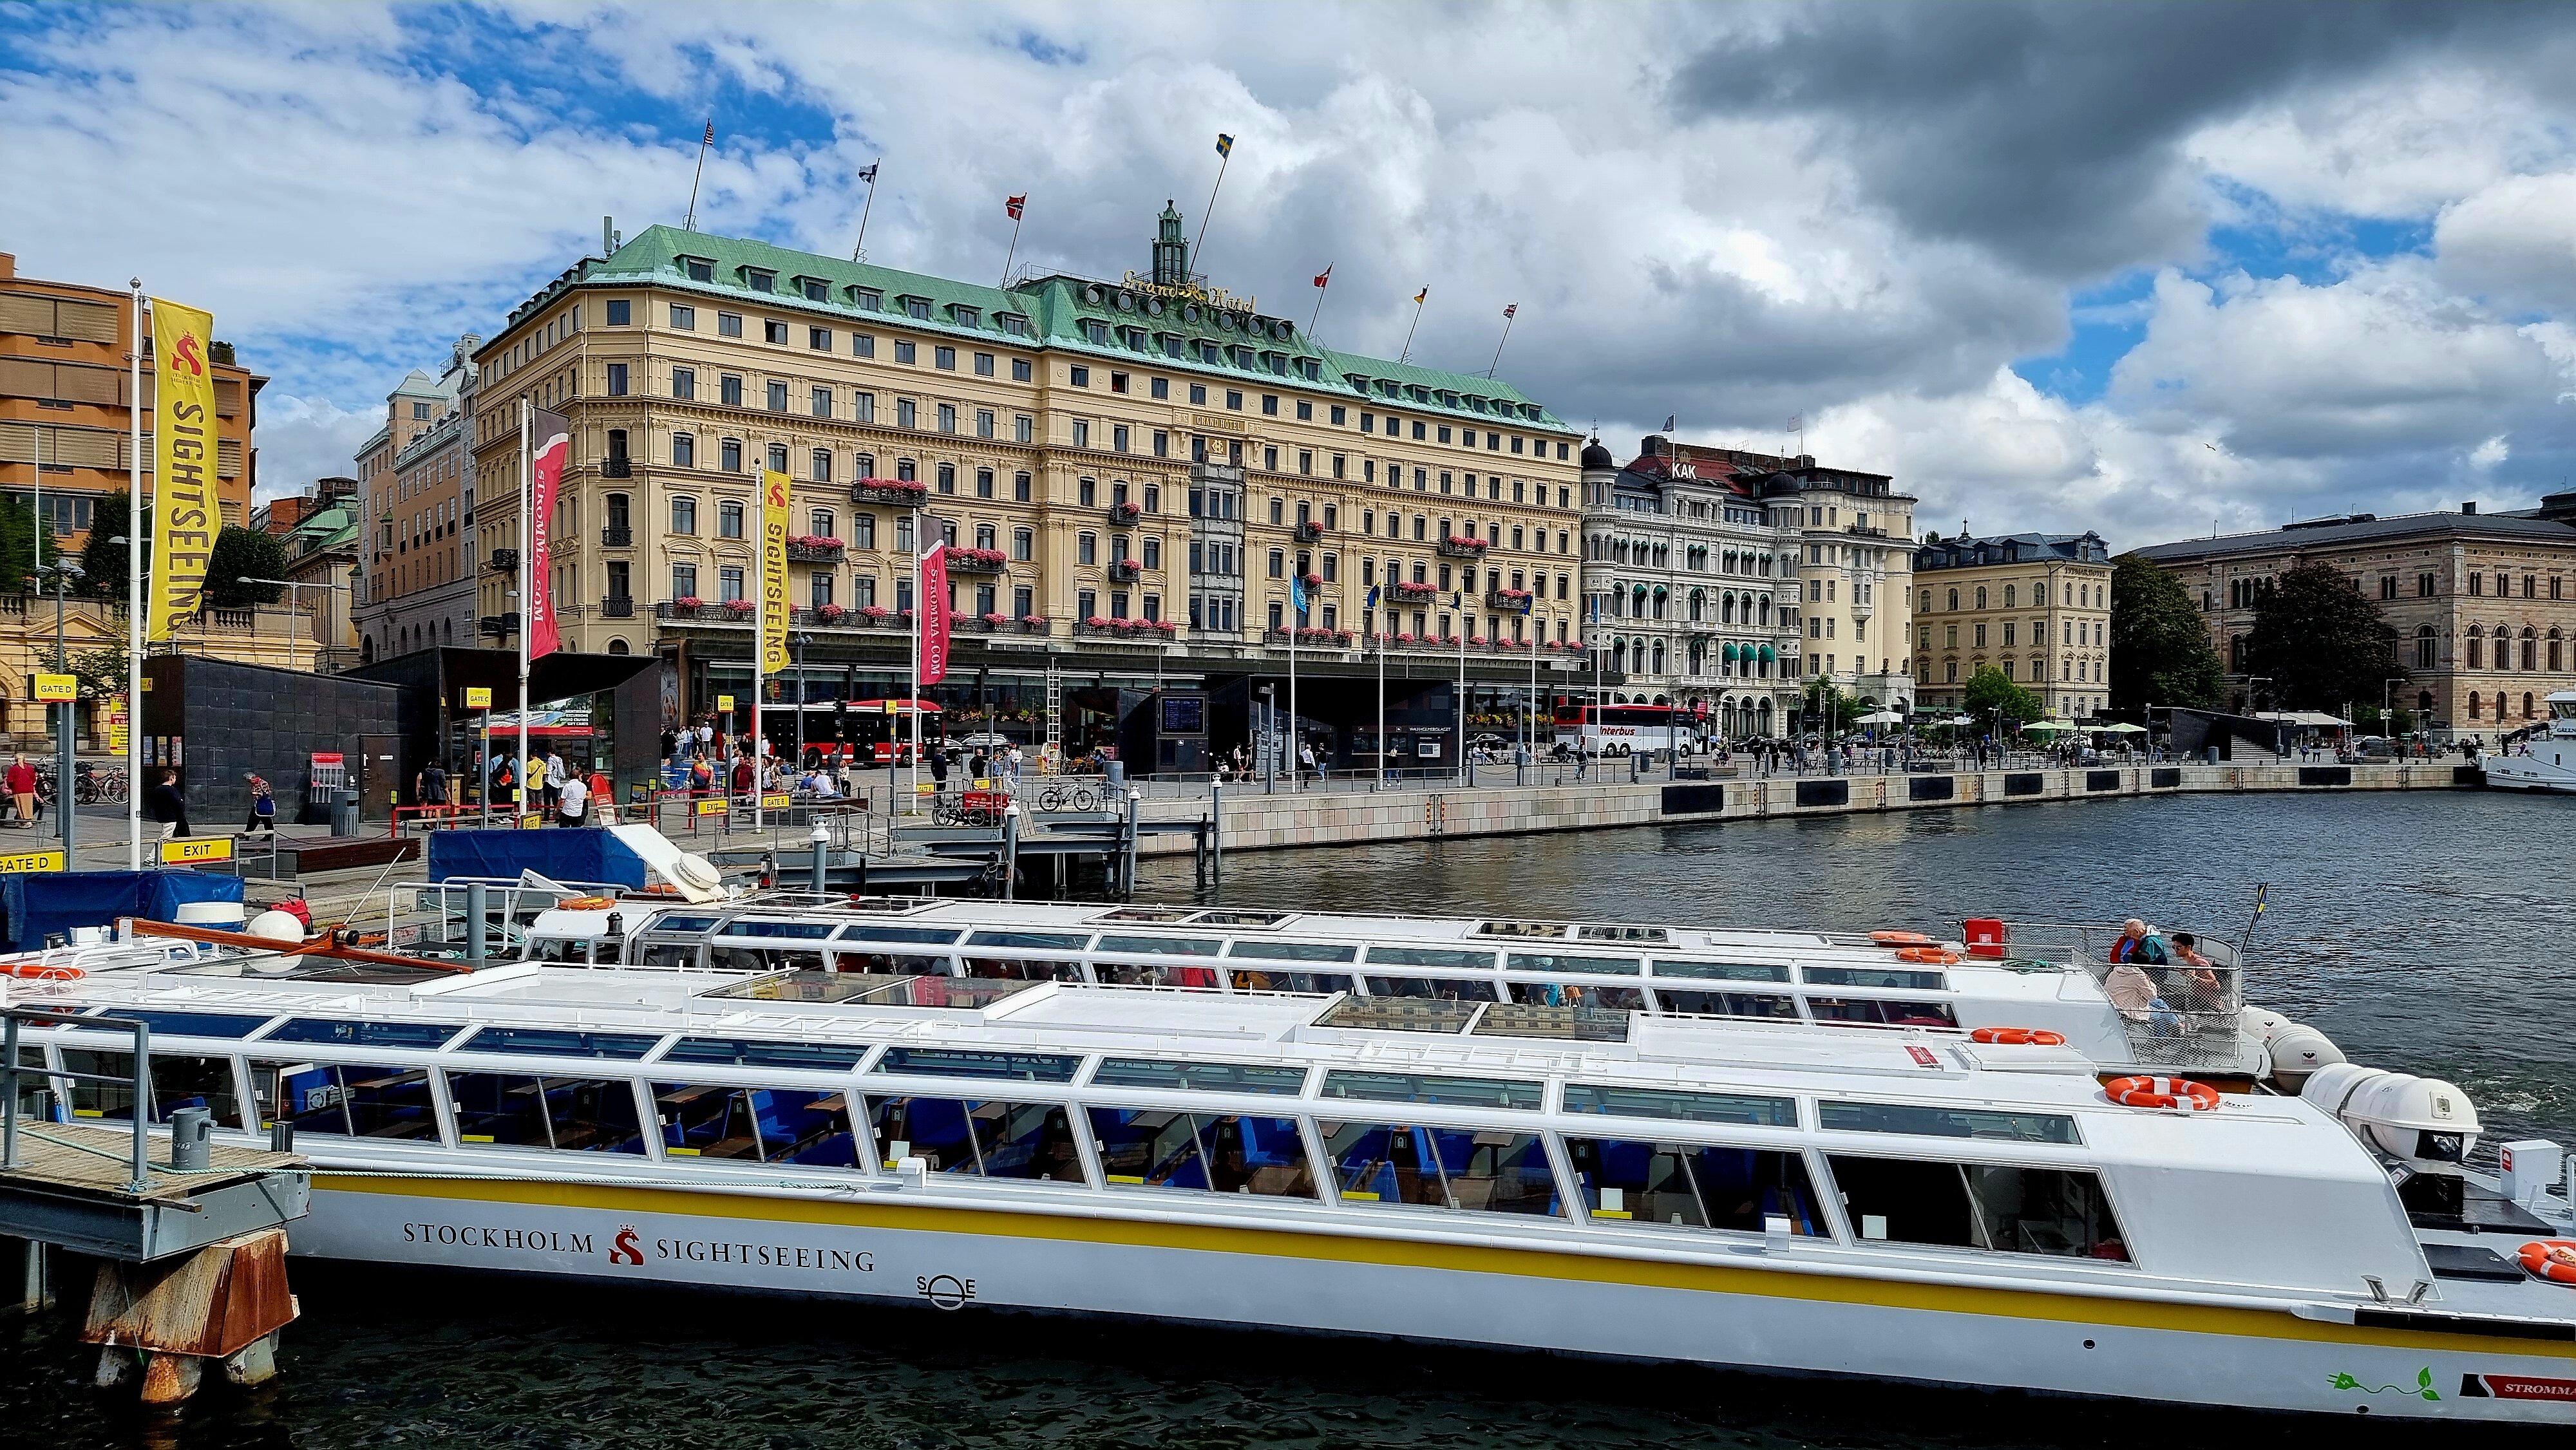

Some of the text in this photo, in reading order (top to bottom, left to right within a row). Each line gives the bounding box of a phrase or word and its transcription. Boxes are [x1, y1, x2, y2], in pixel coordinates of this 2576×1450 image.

[1197, 417, 1218, 427] GRAND
[1672, 462, 1698, 480] KAK
[167, 400, 209, 632] SIGHTSEEING
[765, 522, 782, 663] SIGHTSEEING
[1600, 726, 1636, 736] Interbus
[184, 844, 211, 856] EXIT
[39, 857, 48, 869] D
[403, 1223, 875, 1272] STOCKHOLM SIGHTSEEING
